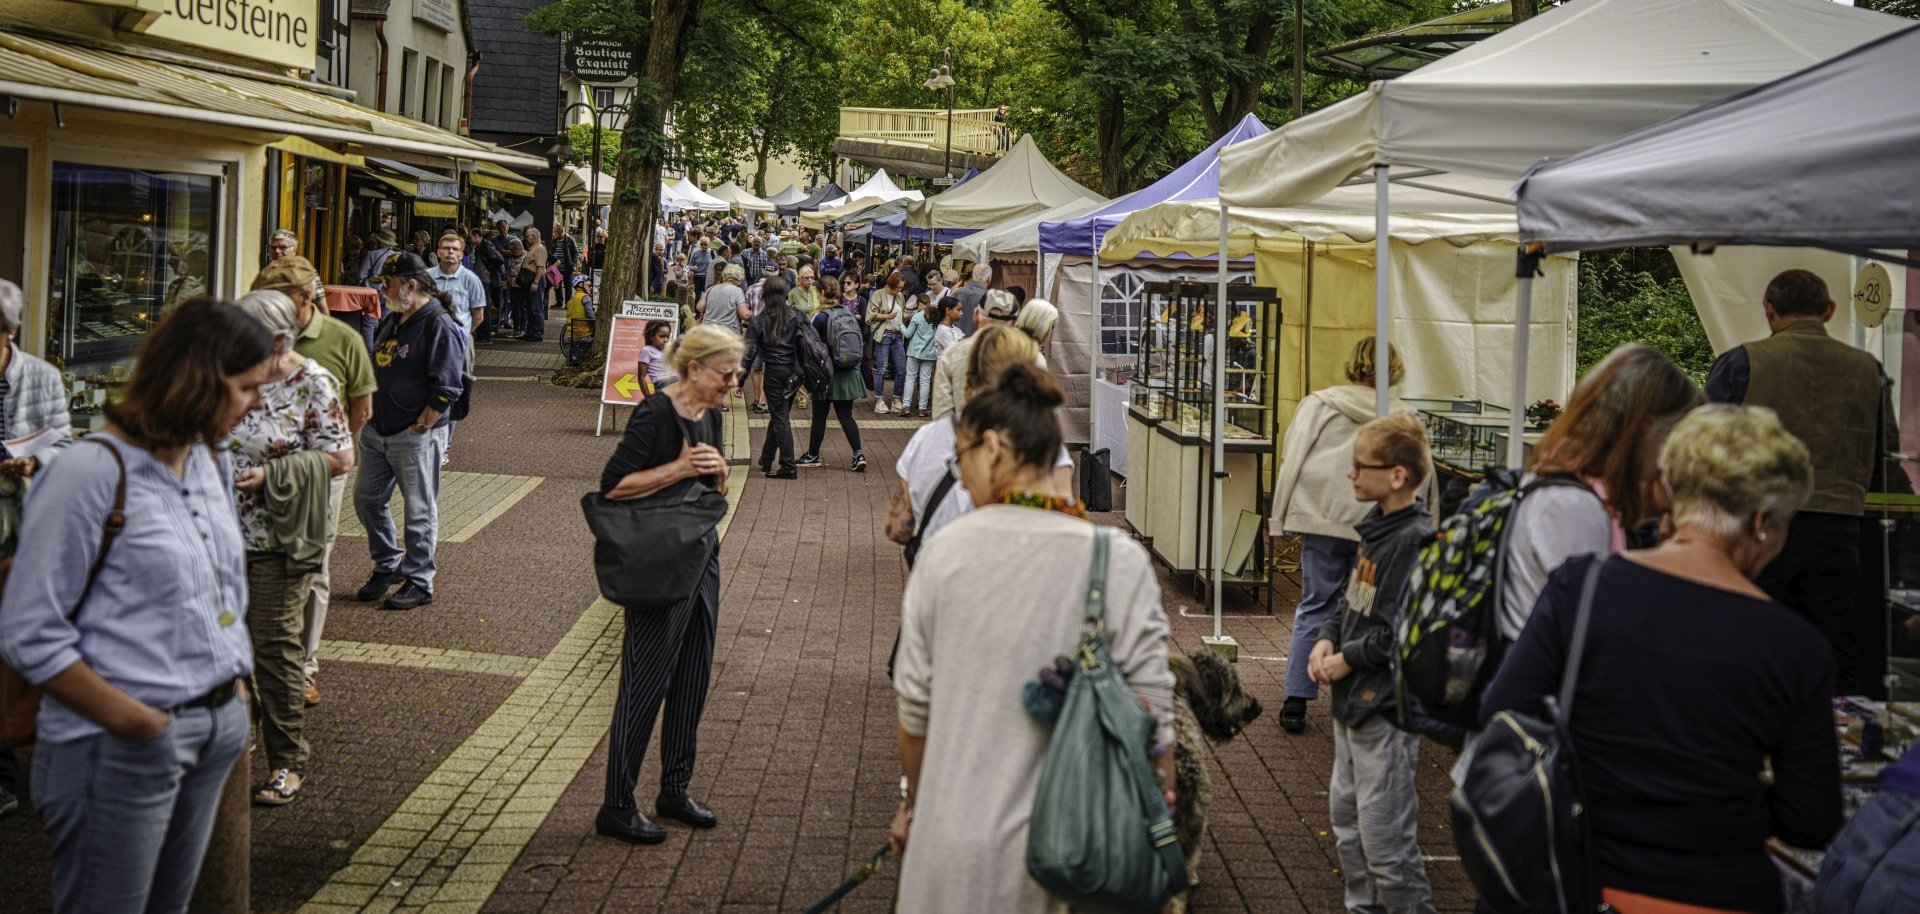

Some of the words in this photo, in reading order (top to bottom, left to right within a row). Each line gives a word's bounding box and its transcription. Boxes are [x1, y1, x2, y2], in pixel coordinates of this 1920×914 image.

[164, 0, 307, 48] elsteine
[574, 46, 632, 59] Boutique
[576, 57, 629, 69] Exquisit
[577, 68, 627, 76] MINERALIEN
[1866, 283, 1881, 304] 28
[631, 304, 661, 313] Pizzeria
